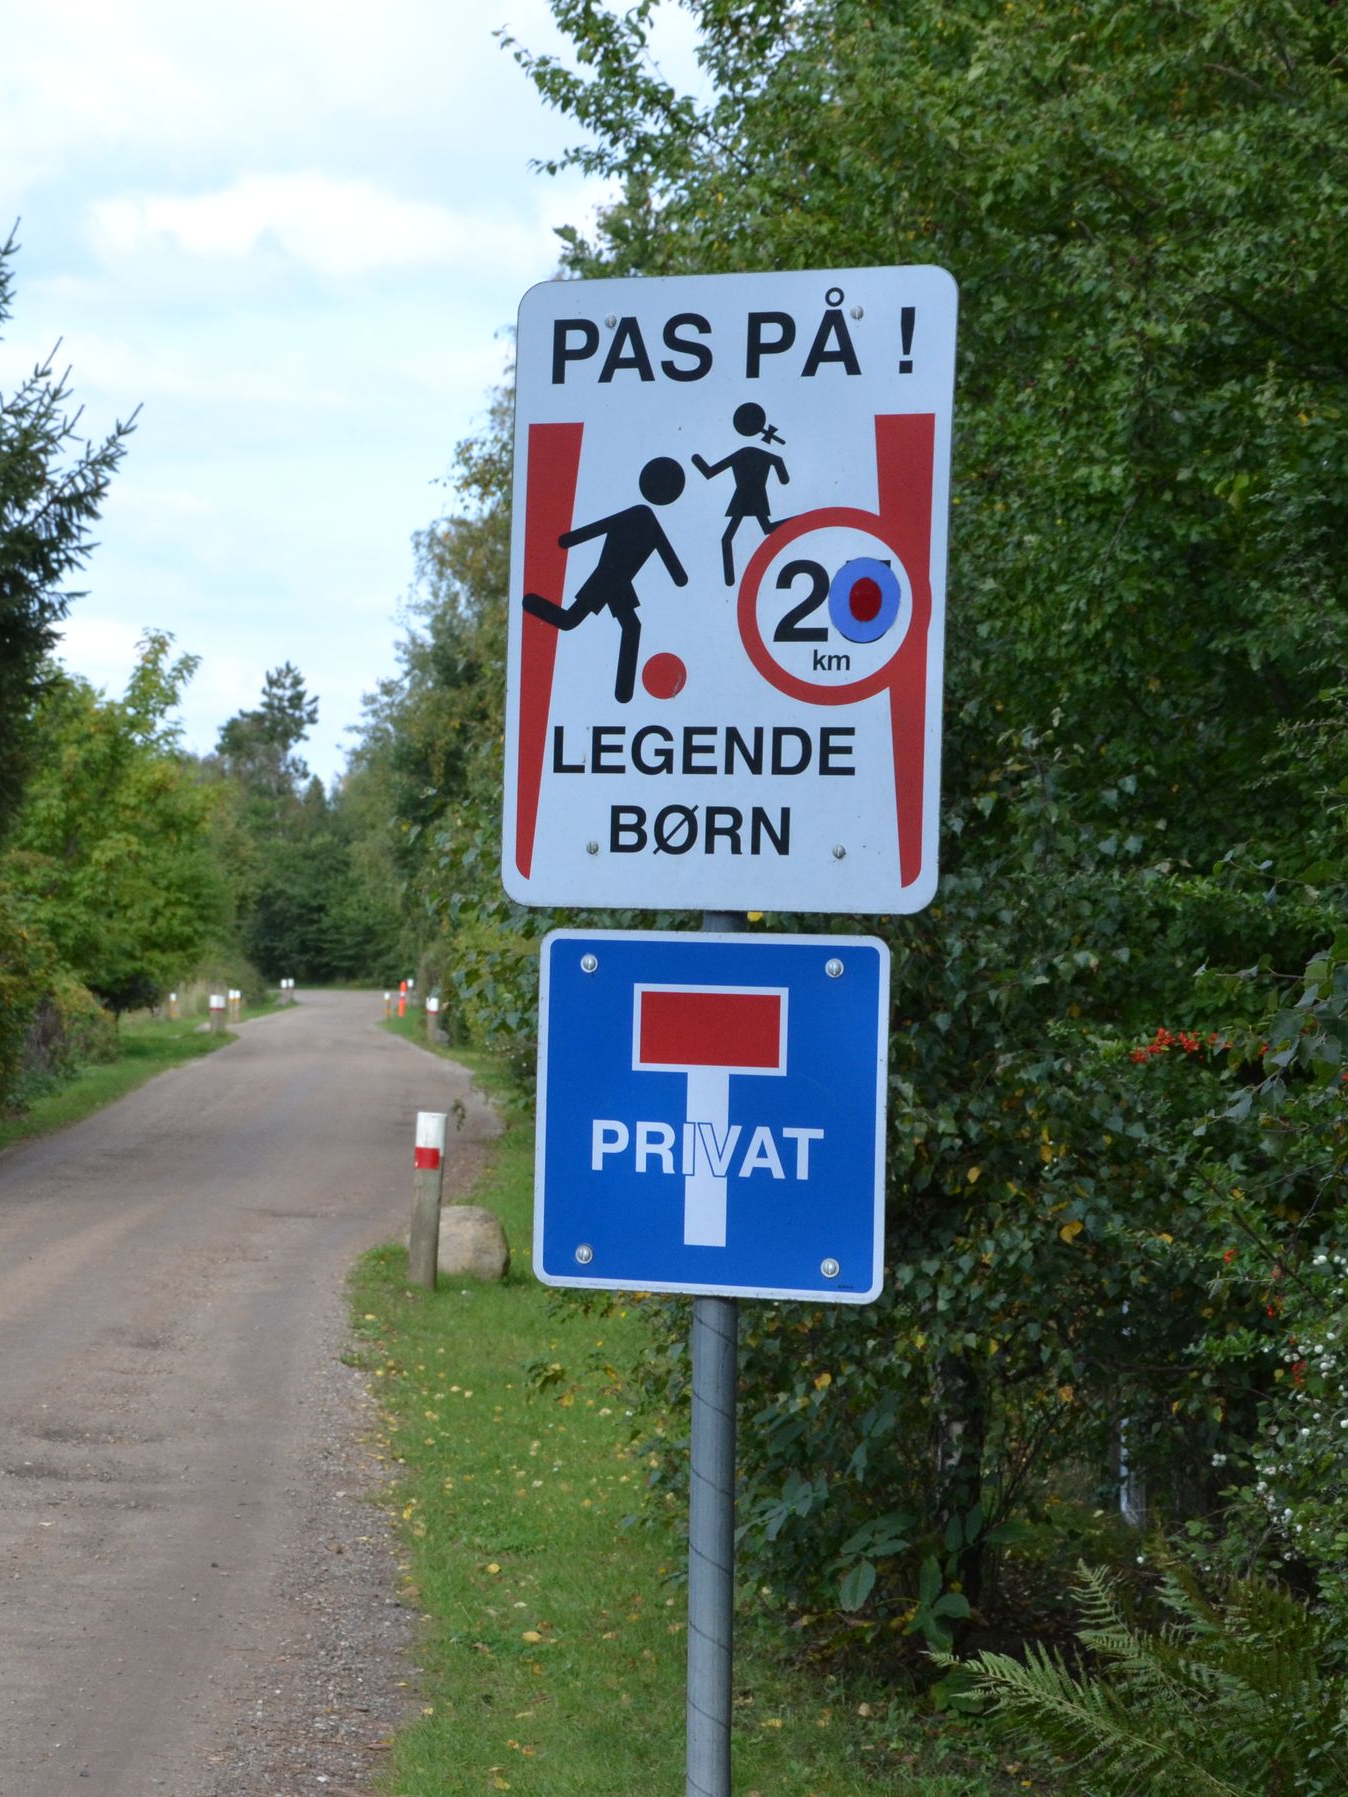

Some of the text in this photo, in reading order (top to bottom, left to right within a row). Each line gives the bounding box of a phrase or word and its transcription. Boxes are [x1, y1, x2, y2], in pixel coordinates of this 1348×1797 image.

[551, 287, 917, 385] PAS PÅ !
[773, 558, 901, 643] 2
[813, 650, 851, 671] km
[552, 725, 857, 776] LEGENDE
[609, 804, 791, 856] BØRN
[591, 1119, 825, 1181] PRIVAT
